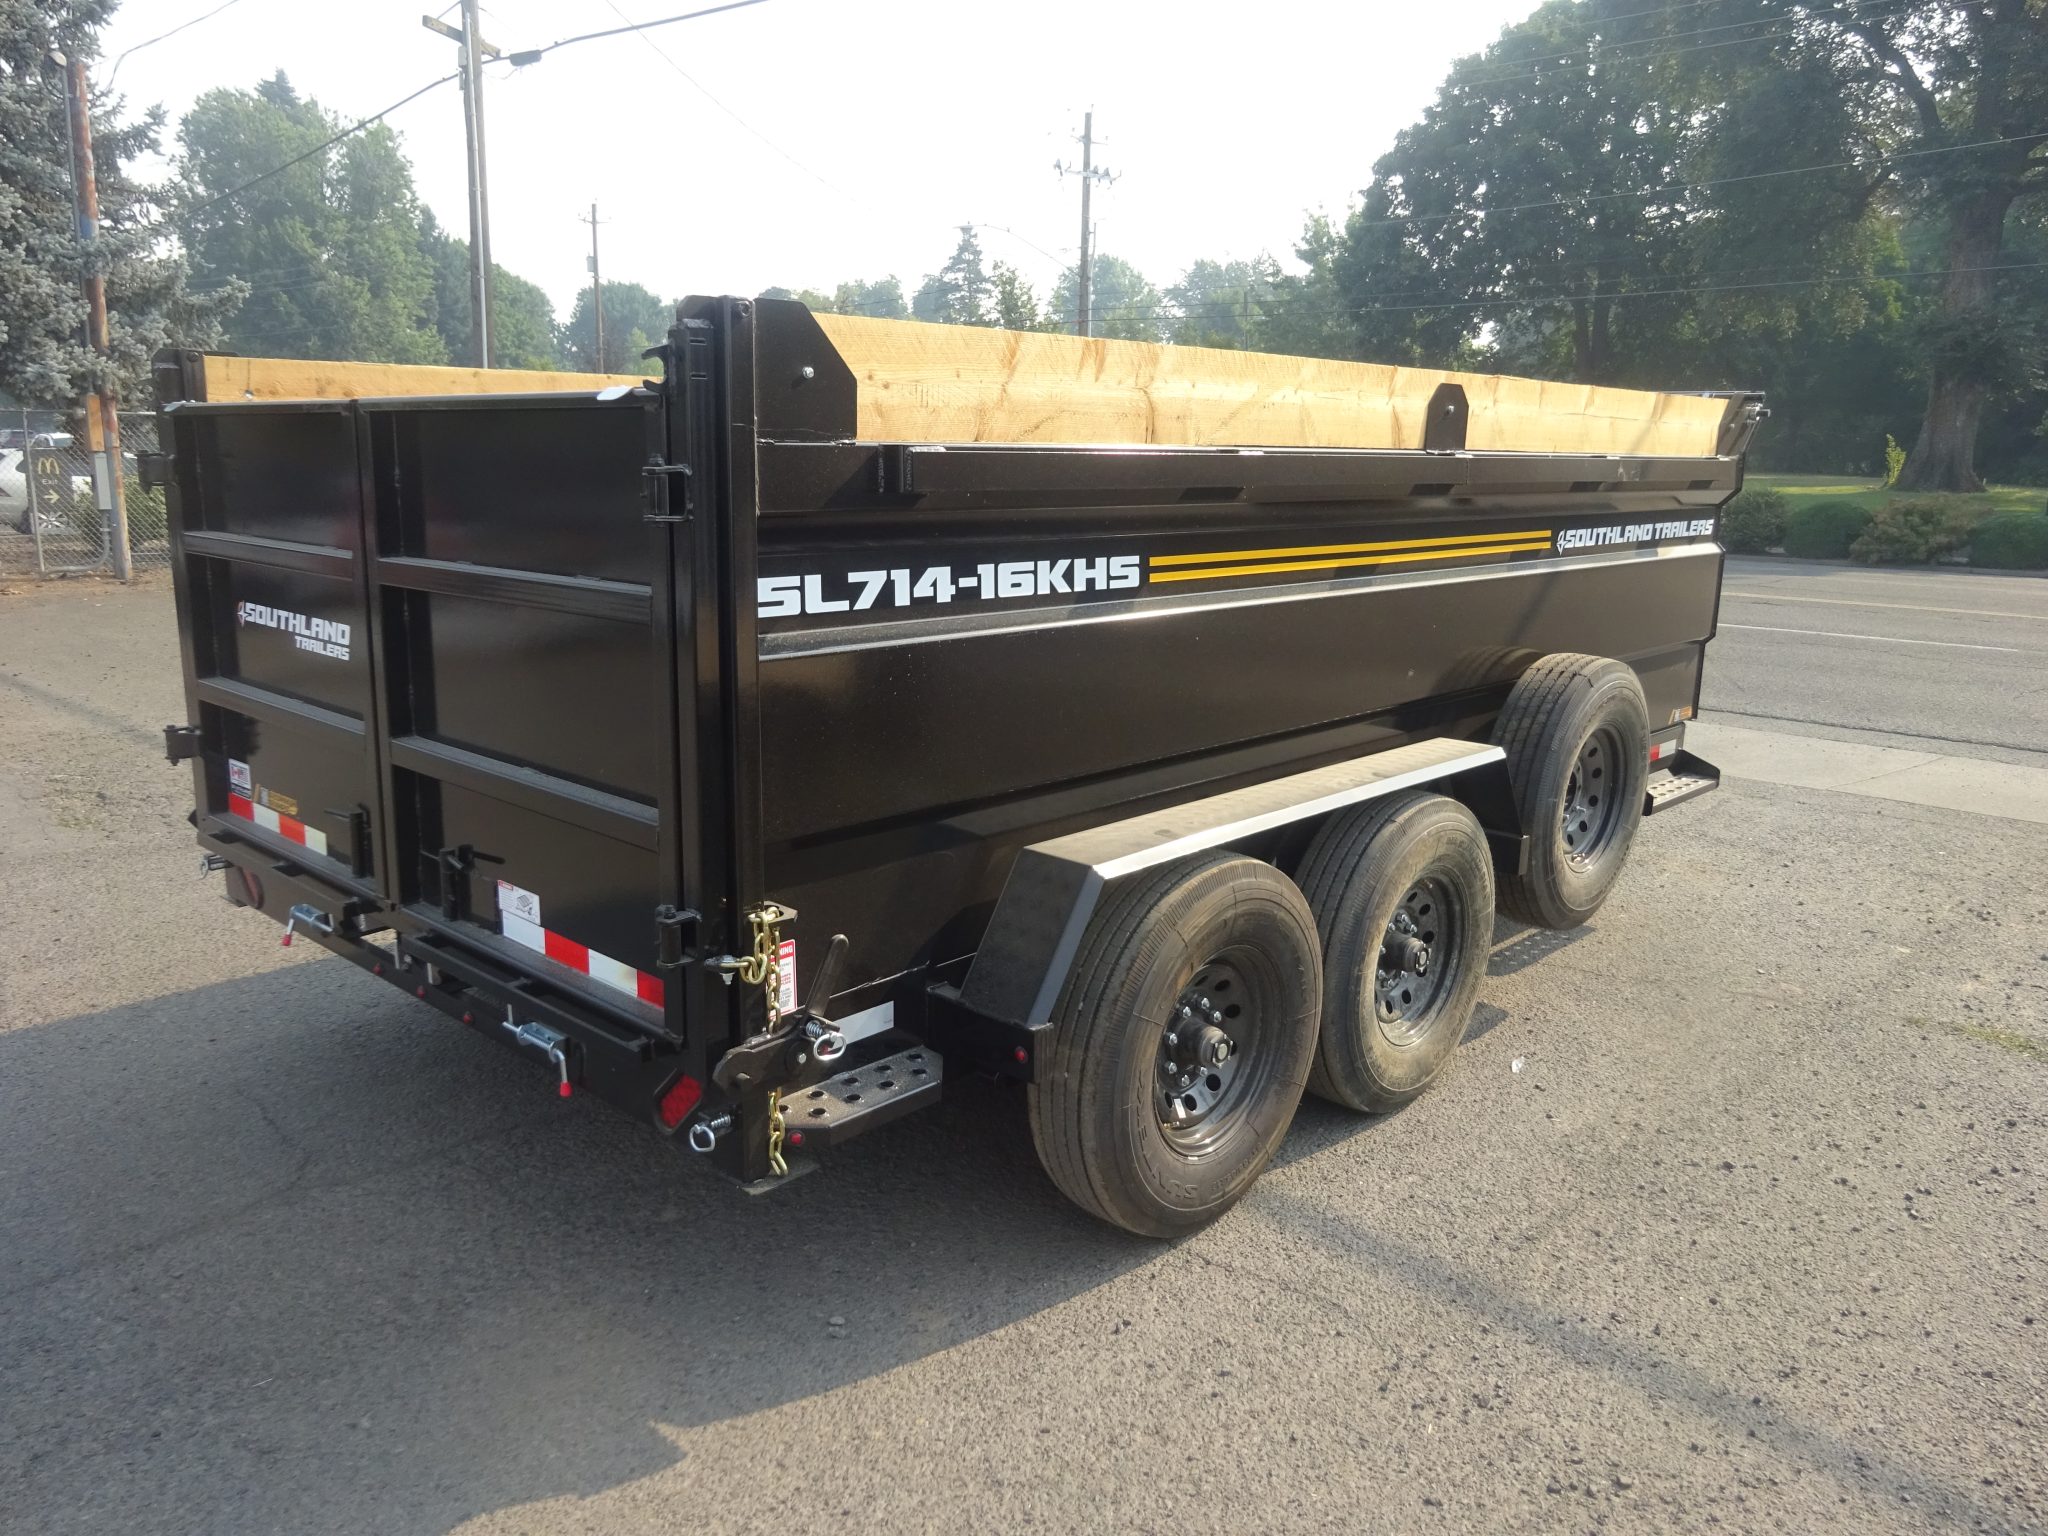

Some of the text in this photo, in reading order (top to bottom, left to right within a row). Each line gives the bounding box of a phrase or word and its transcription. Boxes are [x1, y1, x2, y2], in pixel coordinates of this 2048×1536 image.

[1564, 518, 1715, 548] SOUTHLAND TRAILERS
[757, 555, 1140, 618] SL714-16KHS
[245, 602, 351, 645] SOUTHLAND
[294, 635, 351, 661] TRAILERS
